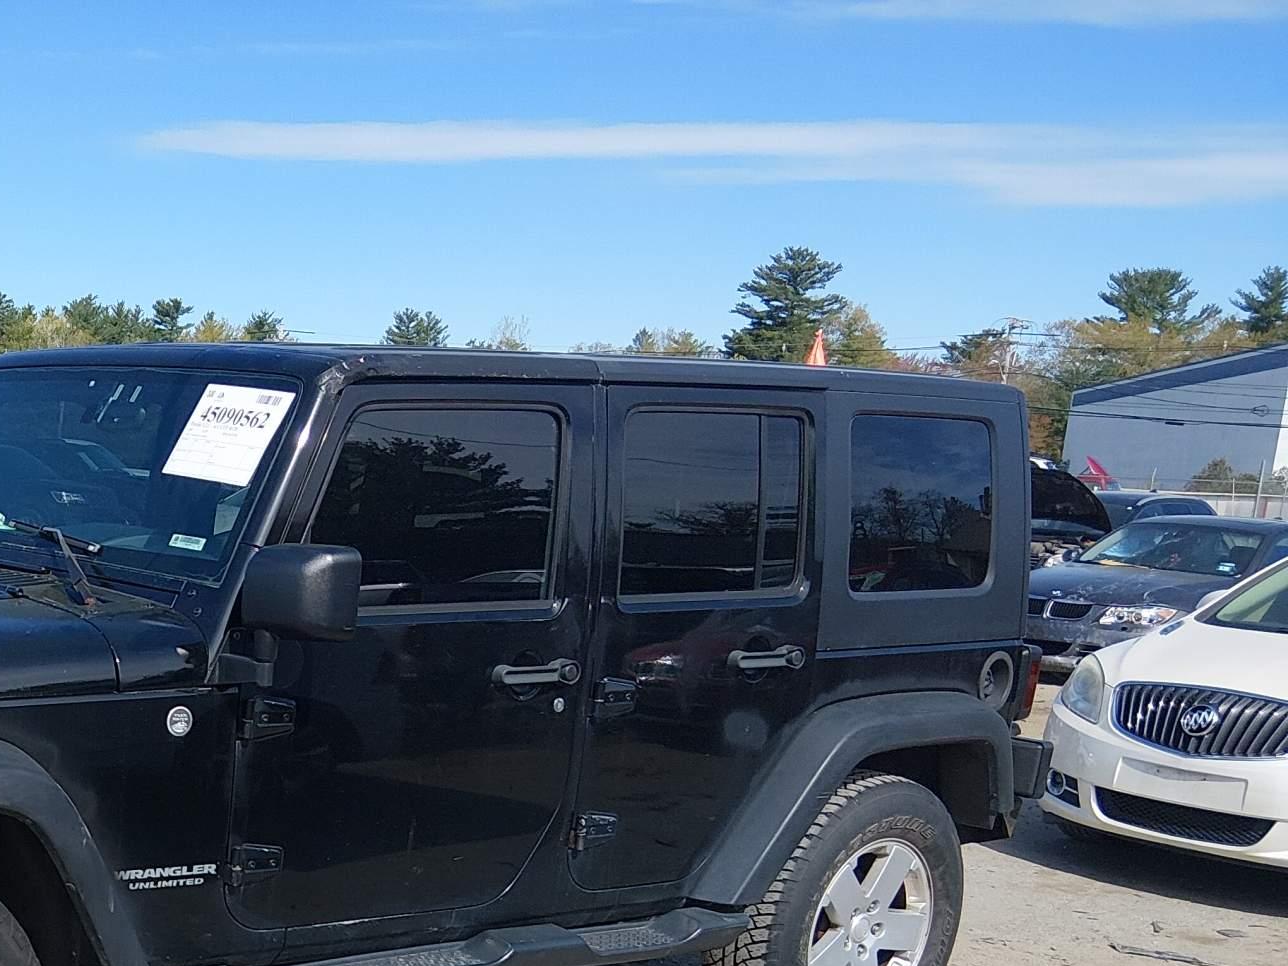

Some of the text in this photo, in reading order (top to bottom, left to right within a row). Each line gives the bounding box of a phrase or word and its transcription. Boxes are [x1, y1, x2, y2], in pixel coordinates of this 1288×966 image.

[200, 404, 271, 429] 45090562
[114, 864, 217, 881] WRANGLER
[128, 878, 204, 890] UNLIMITED
